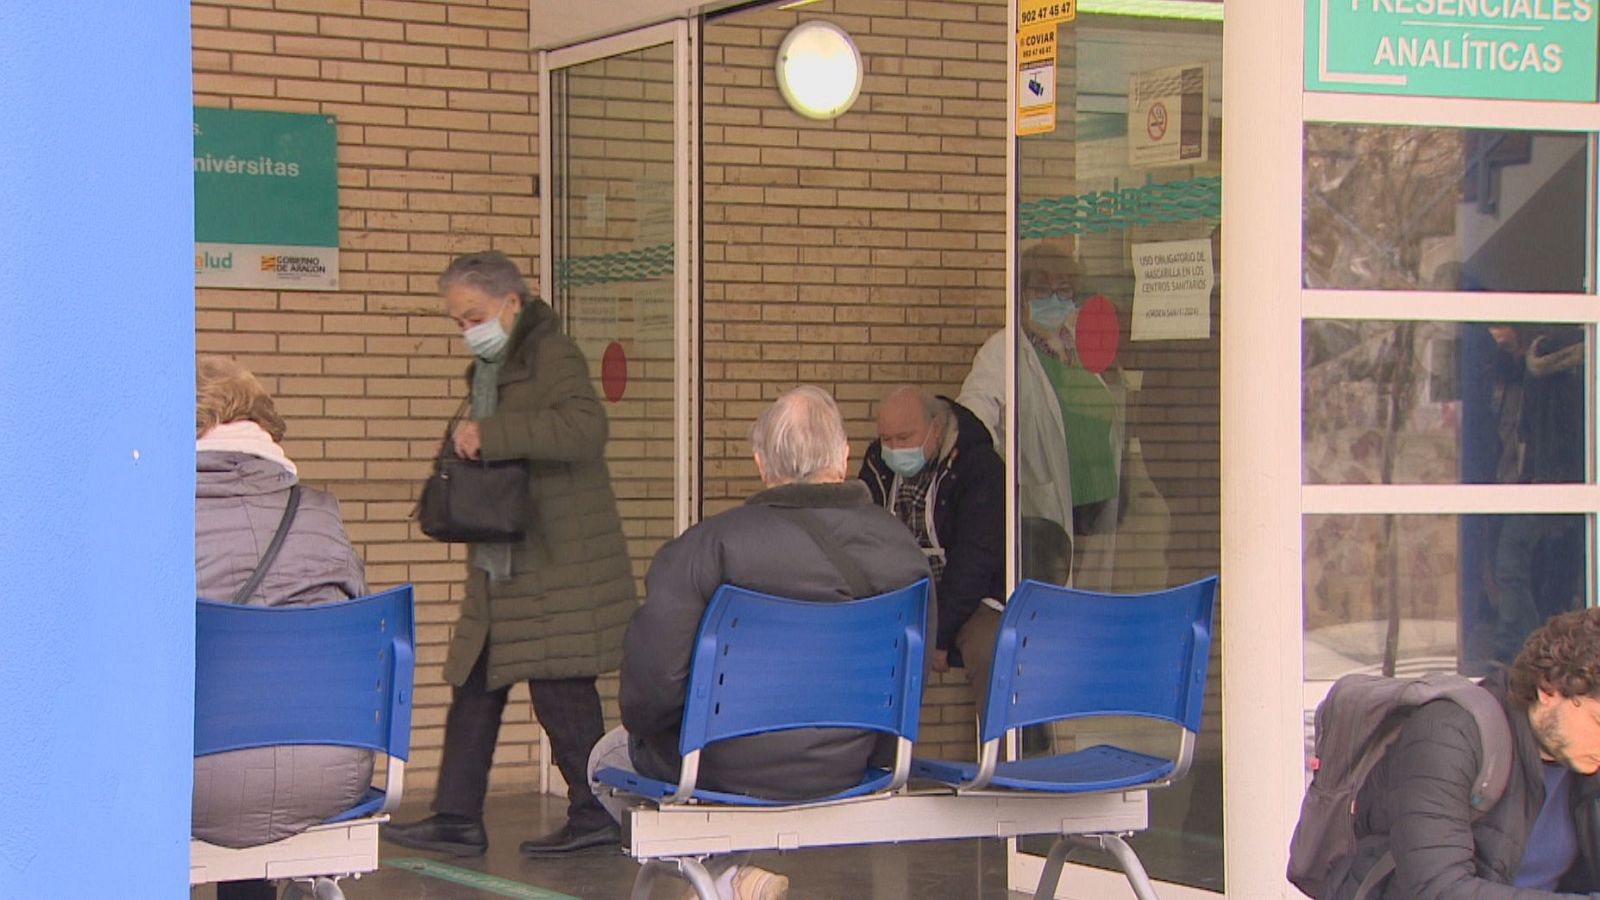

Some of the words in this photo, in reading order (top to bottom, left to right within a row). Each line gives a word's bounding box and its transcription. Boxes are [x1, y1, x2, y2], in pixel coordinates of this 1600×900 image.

[1021, 9, 1036, 23] 902
[1037, 7, 1047, 18] 47
[1049, 4, 1059, 16] 45
[1061, 1, 1071, 13] 47
[1026, 31, 1054, 46] COVIAR
[1373, 32, 1563, 73] ANALÍTICAS
[277, 256, 320, 266] GOBIERNO
[1139, 255, 1153, 266] USO
[1154, 252, 1195, 265] OBLIGATORIO
[1196, 251, 1206, 262] DE
[277, 264, 288, 273] DE
[1144, 267, 1181, 279] MASCARILLA
[1182, 266, 1191, 277] EN
[1192, 266, 1204, 276] LOS
[1142, 281, 1170, 293] CENTROS
[1171, 279, 1206, 291] SANITARIOS
